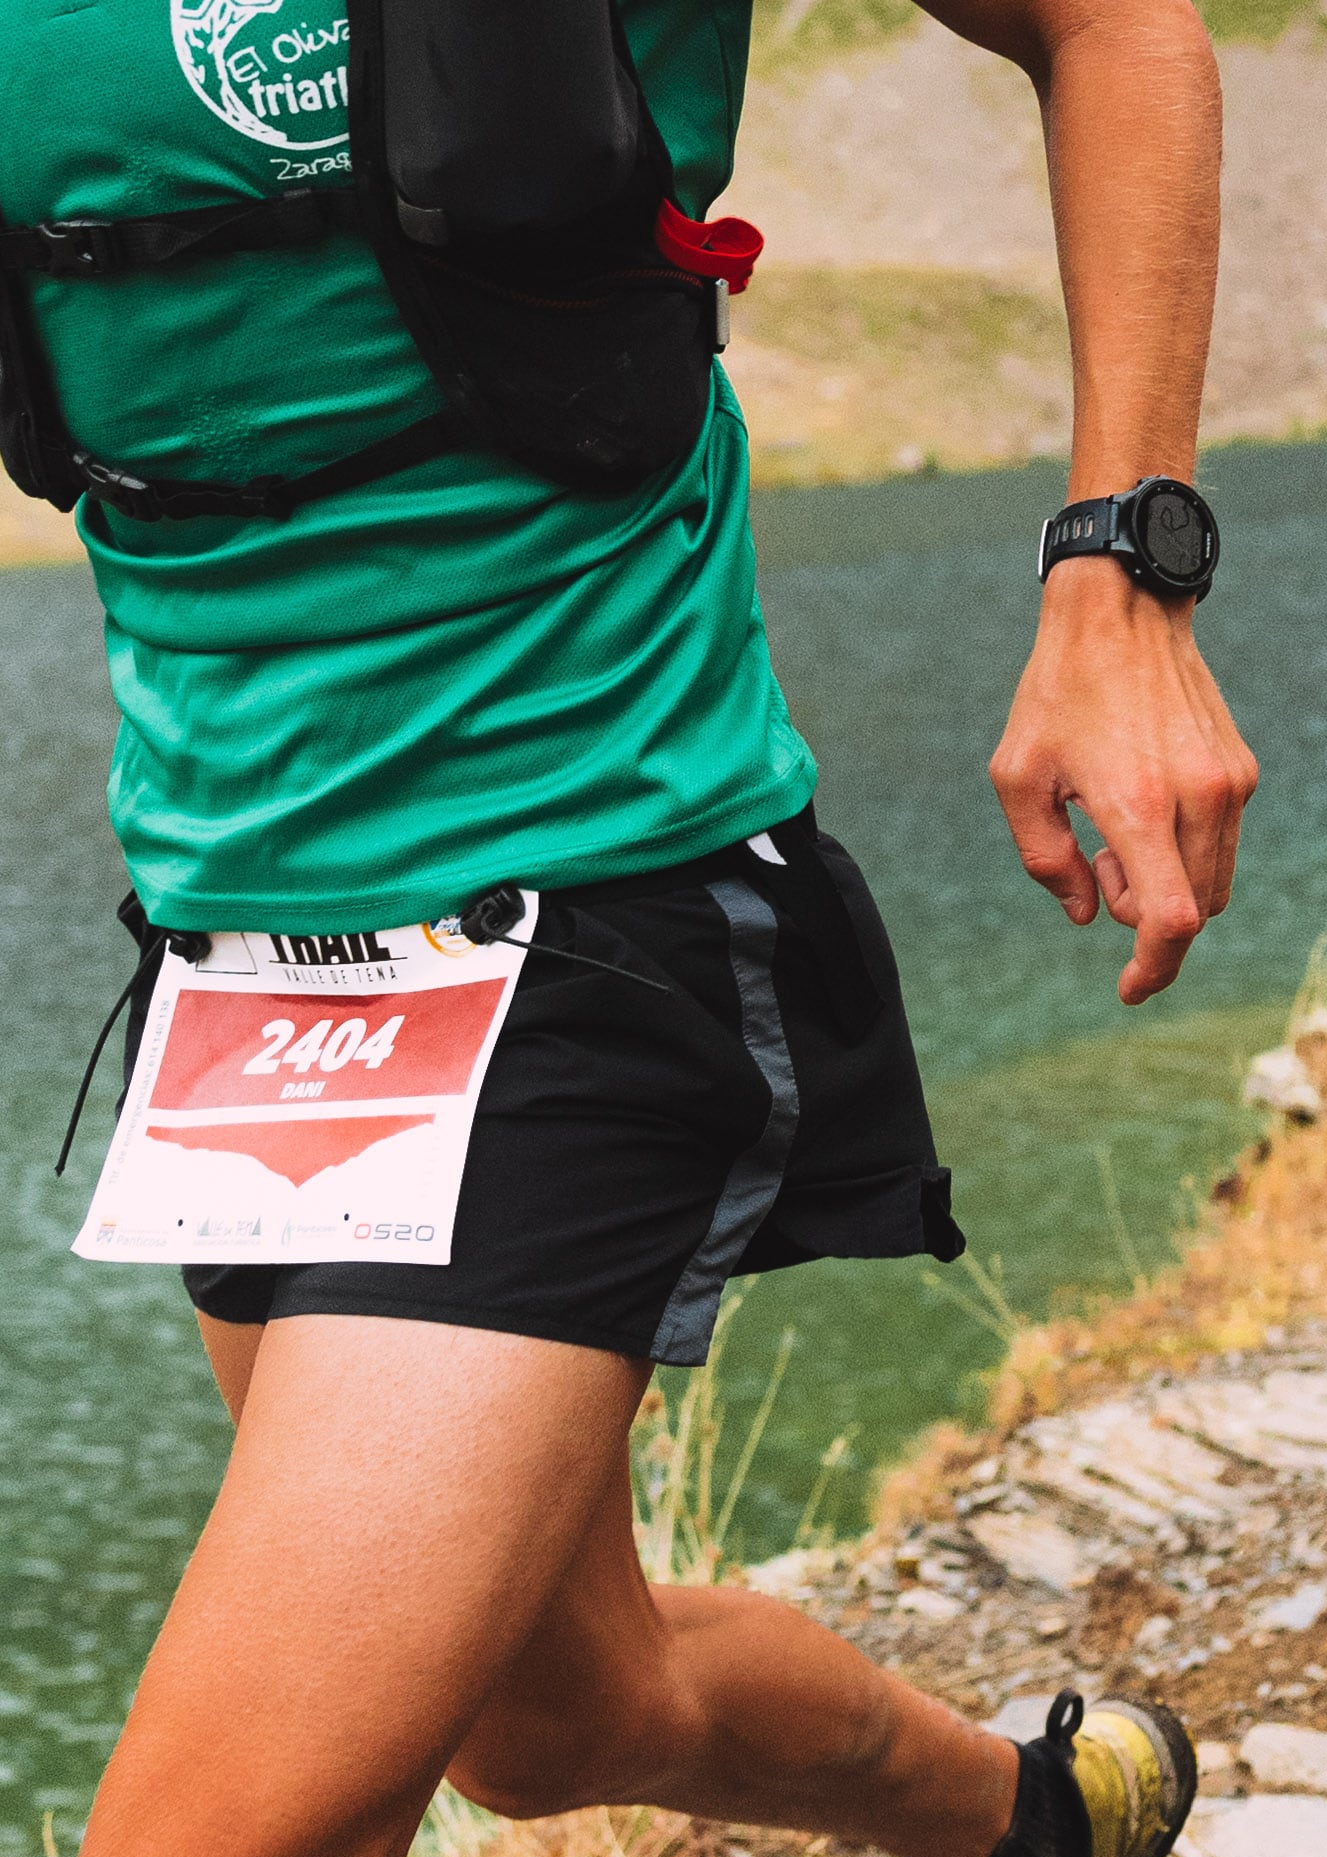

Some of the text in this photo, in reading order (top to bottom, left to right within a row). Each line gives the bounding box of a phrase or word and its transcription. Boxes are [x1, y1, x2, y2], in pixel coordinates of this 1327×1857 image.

[227, 46, 268, 83] El
[283, 965, 397, 984] VALLE DE TENA
[241, 1015, 406, 1075] 2404
[279, 1081, 326, 1099] DANI
